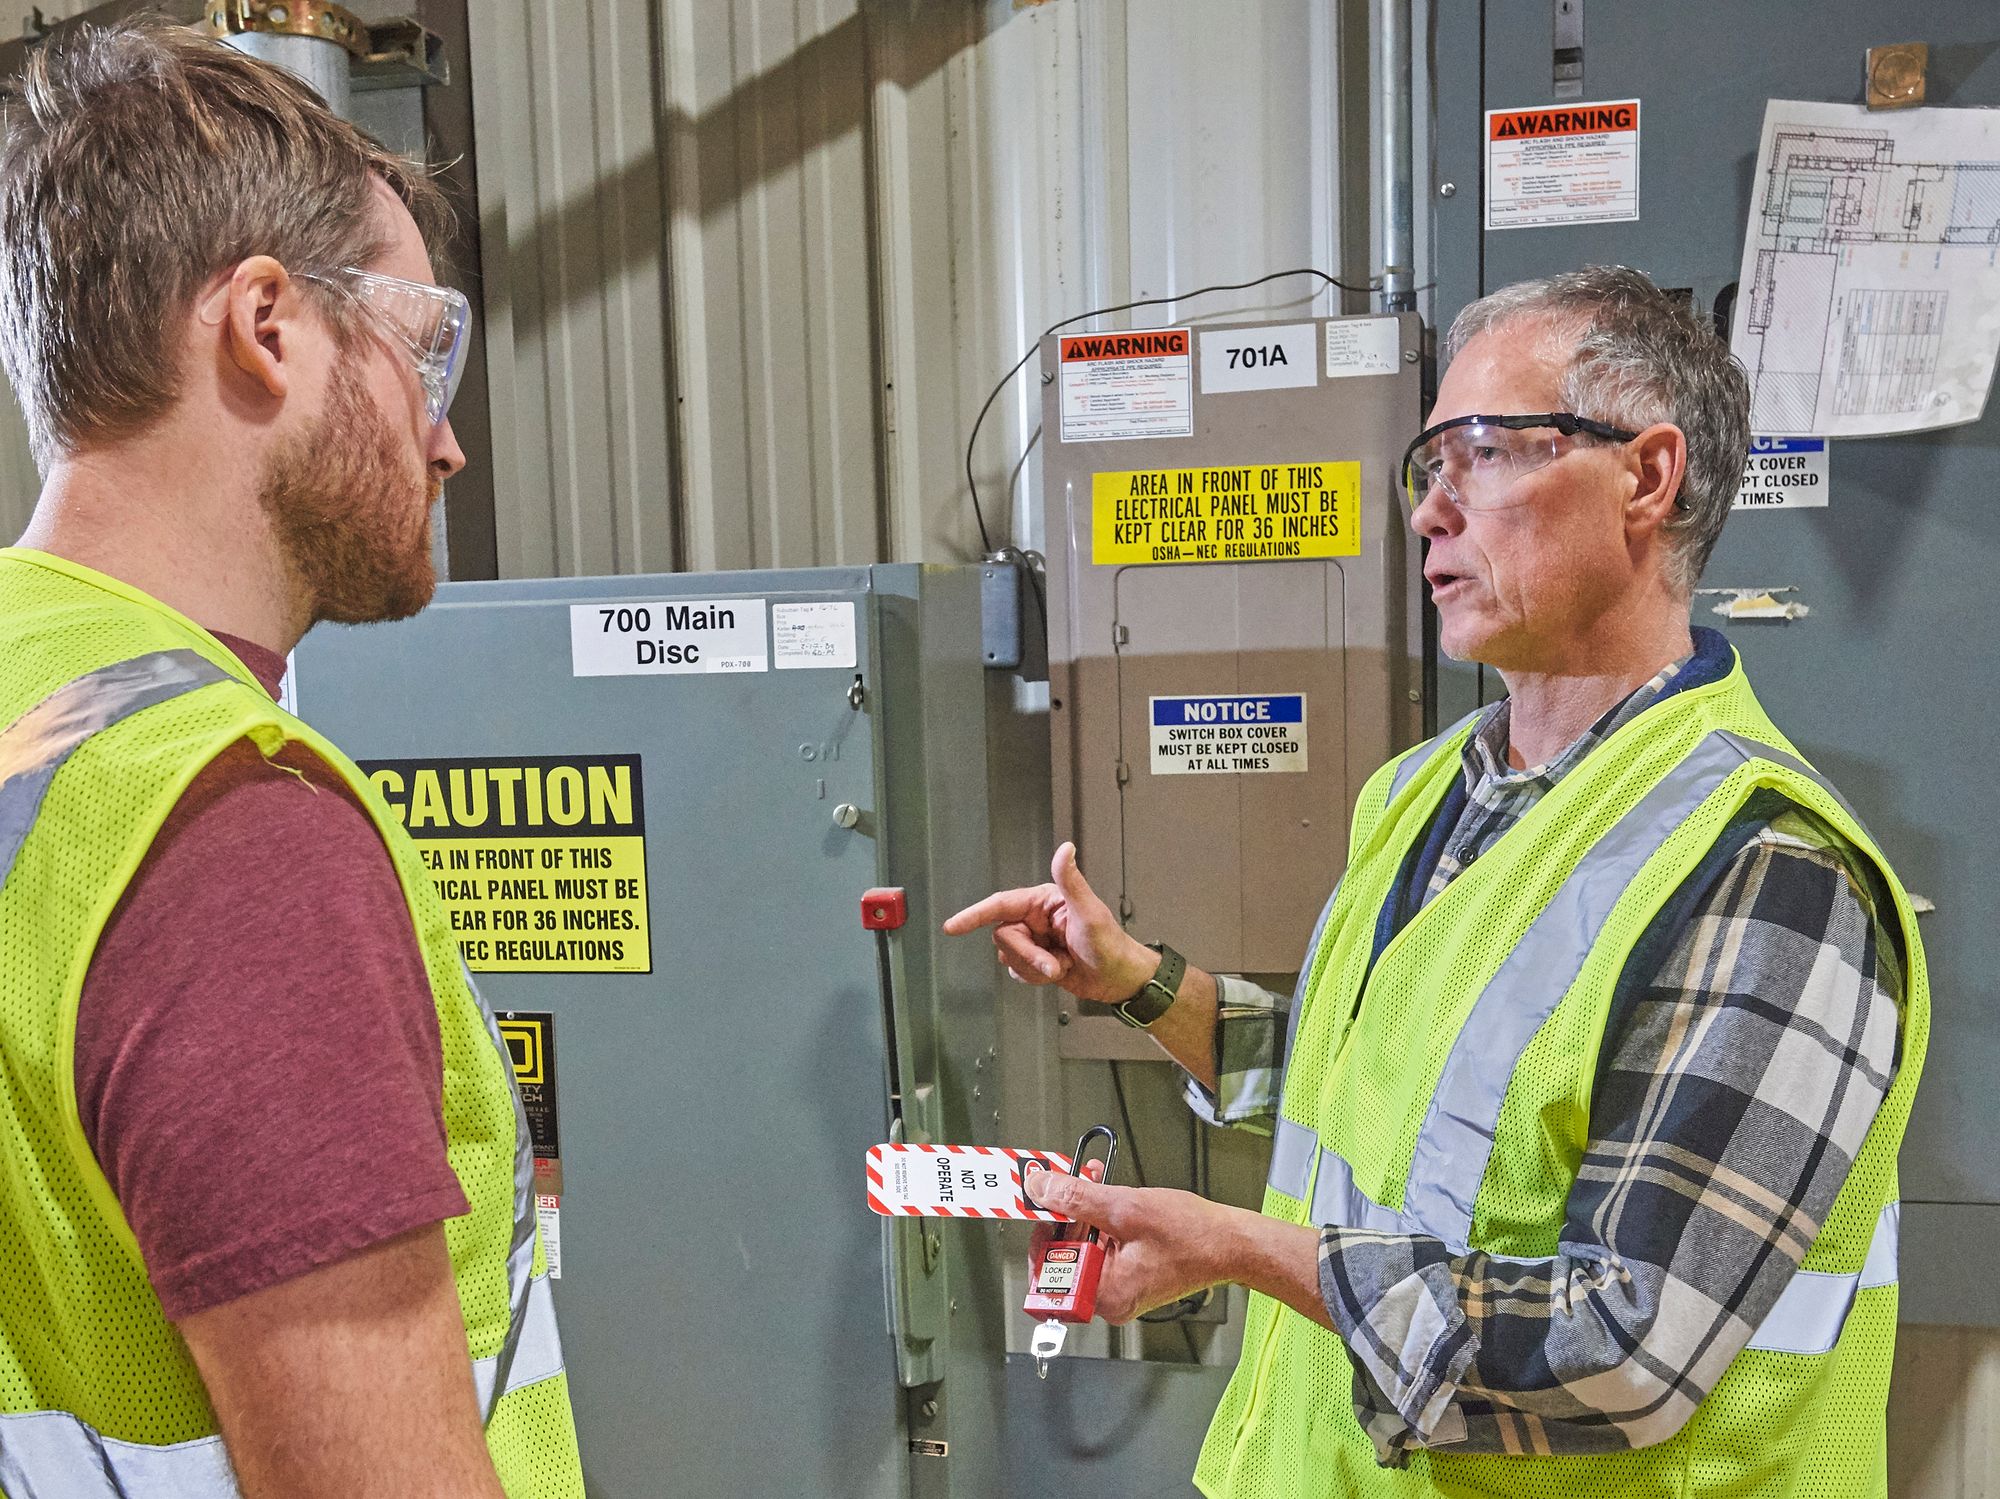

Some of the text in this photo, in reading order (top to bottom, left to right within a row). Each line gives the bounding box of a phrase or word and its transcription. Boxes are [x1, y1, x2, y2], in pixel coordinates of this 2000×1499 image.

[1517, 108, 1631, 135] WARNING
[1084, 335, 1183, 357] WARNING
[1227, 345, 1287, 369] 701A
[1760, 457, 1806, 471] COVER
[1130, 467, 1323, 496] AREA IN FRONT OF THIS
[1764, 473, 1819, 487] CLOSED
[1116, 491, 1338, 522] ELECTRICAL PANEL MUST BE
[1740, 492, 1784, 505] TIMES
[1114, 515, 1339, 544] KEPT CLEAR FOR 36 INCHES
[1225, 541, 1301, 557] REGULATIONS
[600, 605, 735, 632] 700 Main
[637, 640, 700, 665] Disc
[1184, 702, 1271, 722] NOTICE
[1169, 727, 1287, 741] SWITCH BOX COVER
[1159, 742, 1299, 756] MUST BE KEPT CLOSED
[1188, 758, 1270, 770] AT ALL TIMES
[369, 766, 633, 828] CAUTION
[449, 850, 469, 870] IN
[475, 849, 534, 870] FRONT
[541, 849, 563, 869] OF
[570, 848, 613, 869] THIS
[488, 880, 548, 900] PANEL
[555, 879, 608, 900] MUST
[615, 879, 639, 899] BE
[493, 910, 528, 931] FOR
[534, 910, 557, 931] 36
[563, 910, 640, 930] INCHES.
[495, 940, 625, 961] REGULATIONS
[936, 1157, 954, 1202] OPERATE
[961, 1169, 976, 1191] NOT
[983, 1173, 998, 1188] DO
[1050, 1252, 1075, 1260] DANGER
[1044, 1266, 1073, 1274] LOCKED
[1049, 1276, 1064, 1284] OUT
